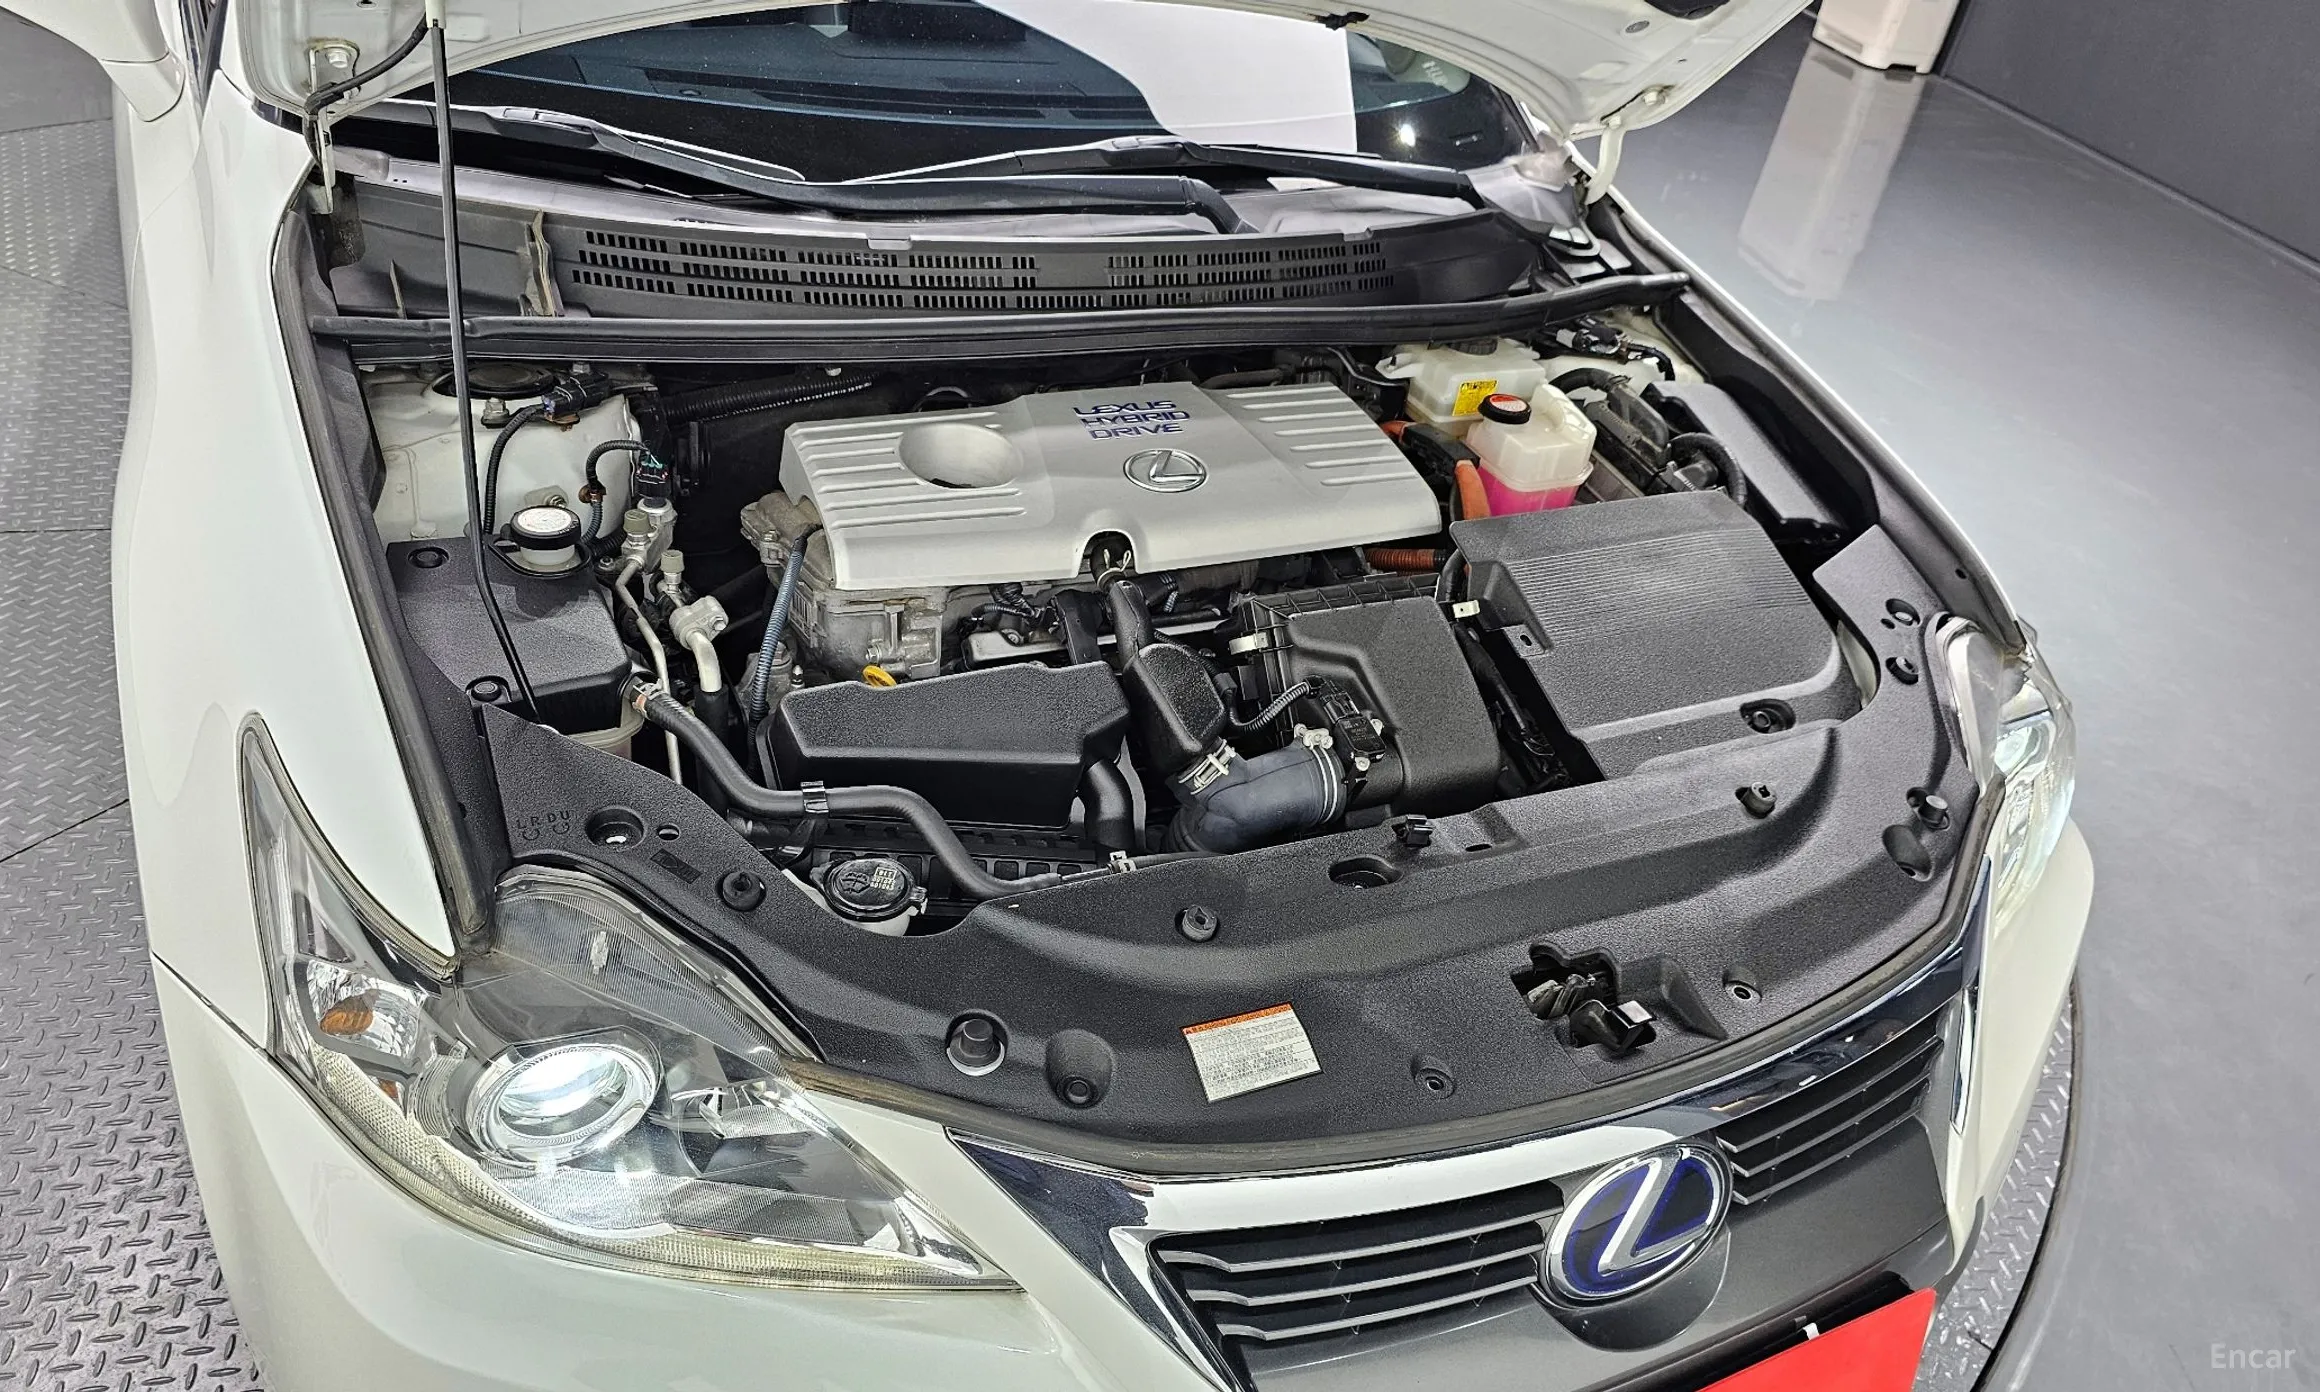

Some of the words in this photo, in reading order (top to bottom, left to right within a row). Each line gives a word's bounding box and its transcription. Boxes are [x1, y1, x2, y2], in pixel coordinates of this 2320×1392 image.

[1072, 400, 1177, 417] LEXUS
[1081, 411, 1191, 428] HYBRID
[1089, 422, 1184, 440] DRIVE
